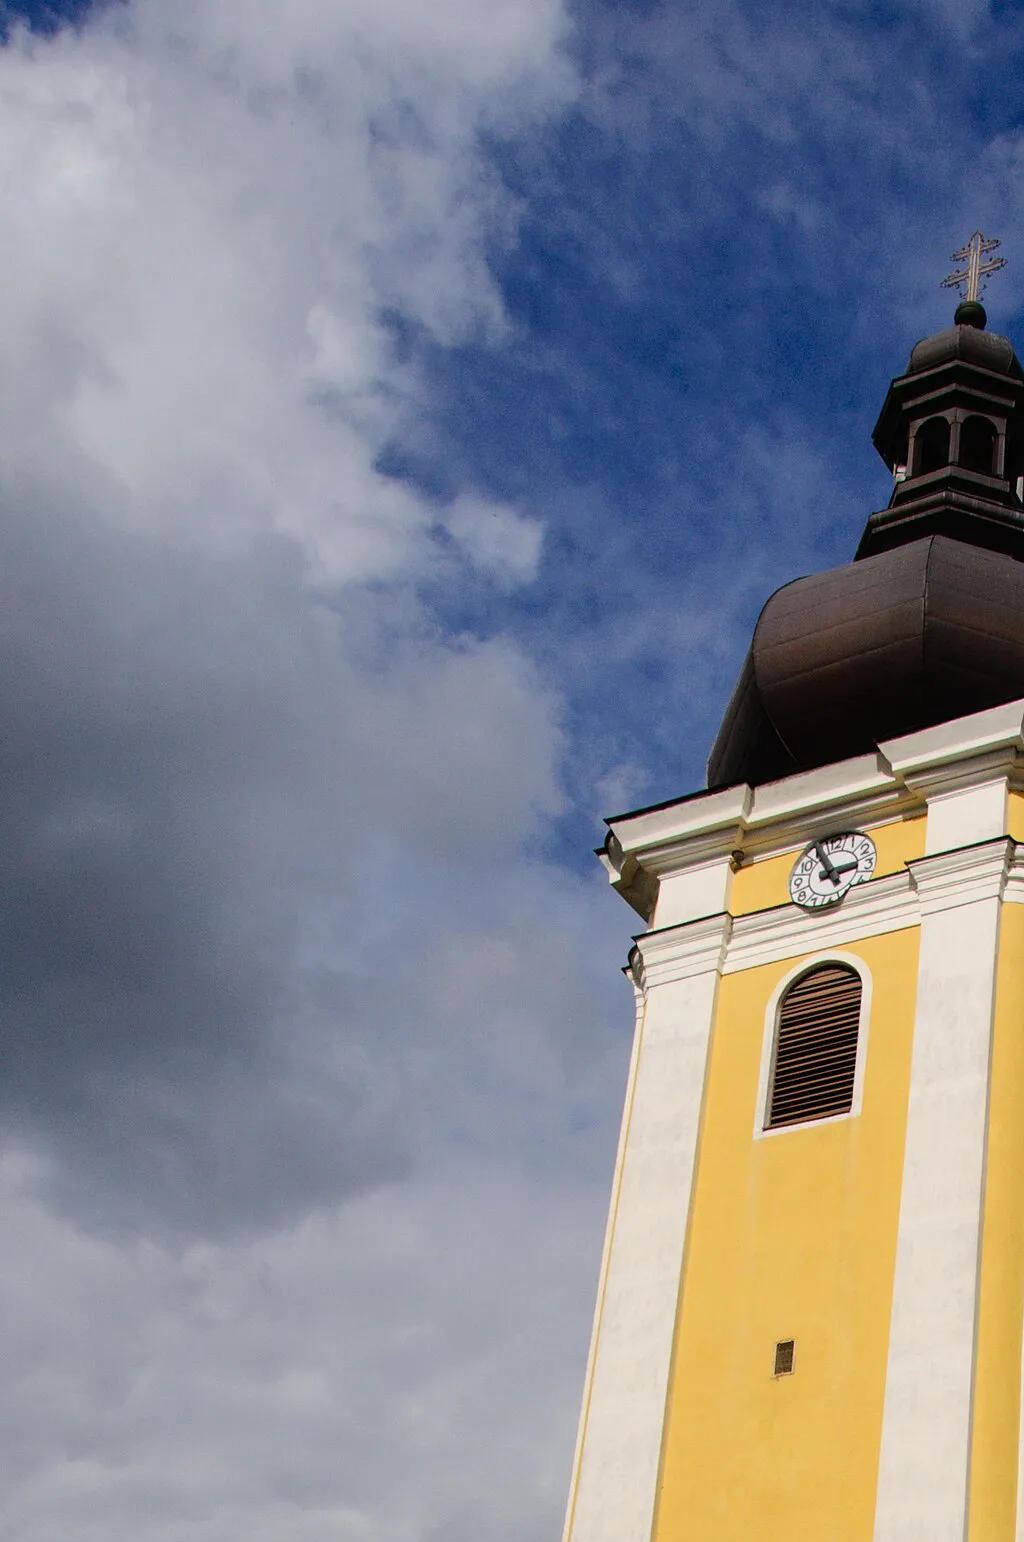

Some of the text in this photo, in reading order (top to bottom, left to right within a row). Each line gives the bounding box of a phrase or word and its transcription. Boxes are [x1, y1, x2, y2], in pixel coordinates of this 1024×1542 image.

[860, 843, 870, 855] 2
[801, 861, 812, 873] 10
[864, 856, 873, 869] 3
[794, 878, 803, 888] 9
[798, 890, 806, 901] 8
